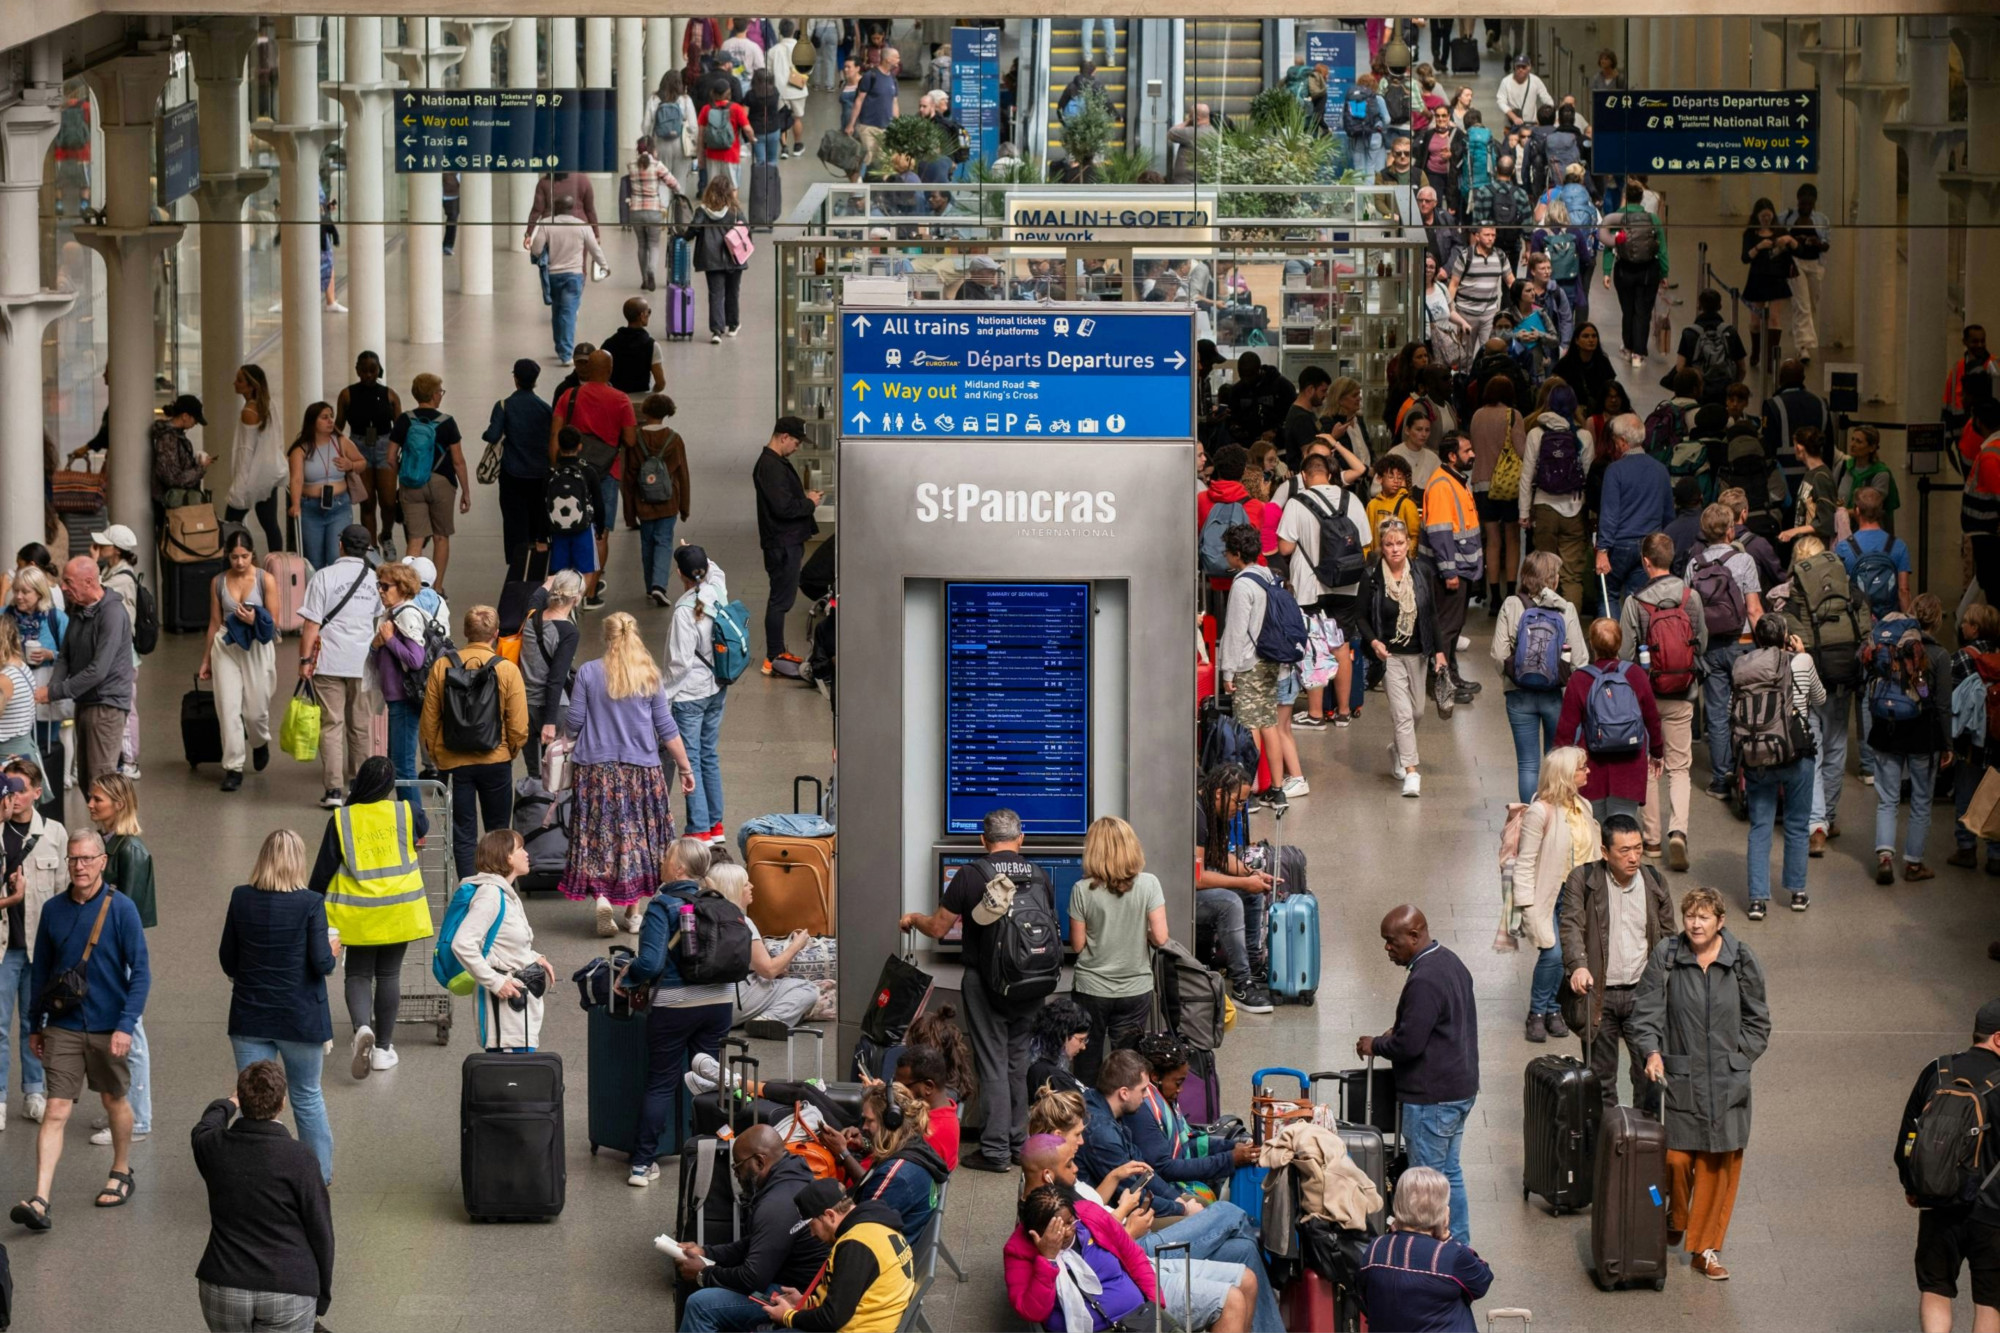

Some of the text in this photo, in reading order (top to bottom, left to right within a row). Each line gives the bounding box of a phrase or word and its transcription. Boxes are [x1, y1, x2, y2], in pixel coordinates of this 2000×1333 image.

[422, 95, 497, 106] National Rail
[1673, 96, 1790, 109] Départs Departures
[422, 116, 468, 128] Way out
[1713, 116, 1790, 127] National Rail
[423, 136, 453, 146] Taxis
[1743, 136, 1790, 149] Way out
[1015, 230, 1094, 241] new york
[977, 316, 1046, 325] National tickets
[883, 319, 970, 335] All trains
[977, 327, 1039, 337] and platforms
[967, 350, 1154, 371] Départs Departures
[965, 380, 1024, 389] Midland Road
[883, 382, 957, 402] Way out
[965, 391, 1039, 400] and King's Cross
[1018, 529, 1115, 537] INTERNATIONAL
